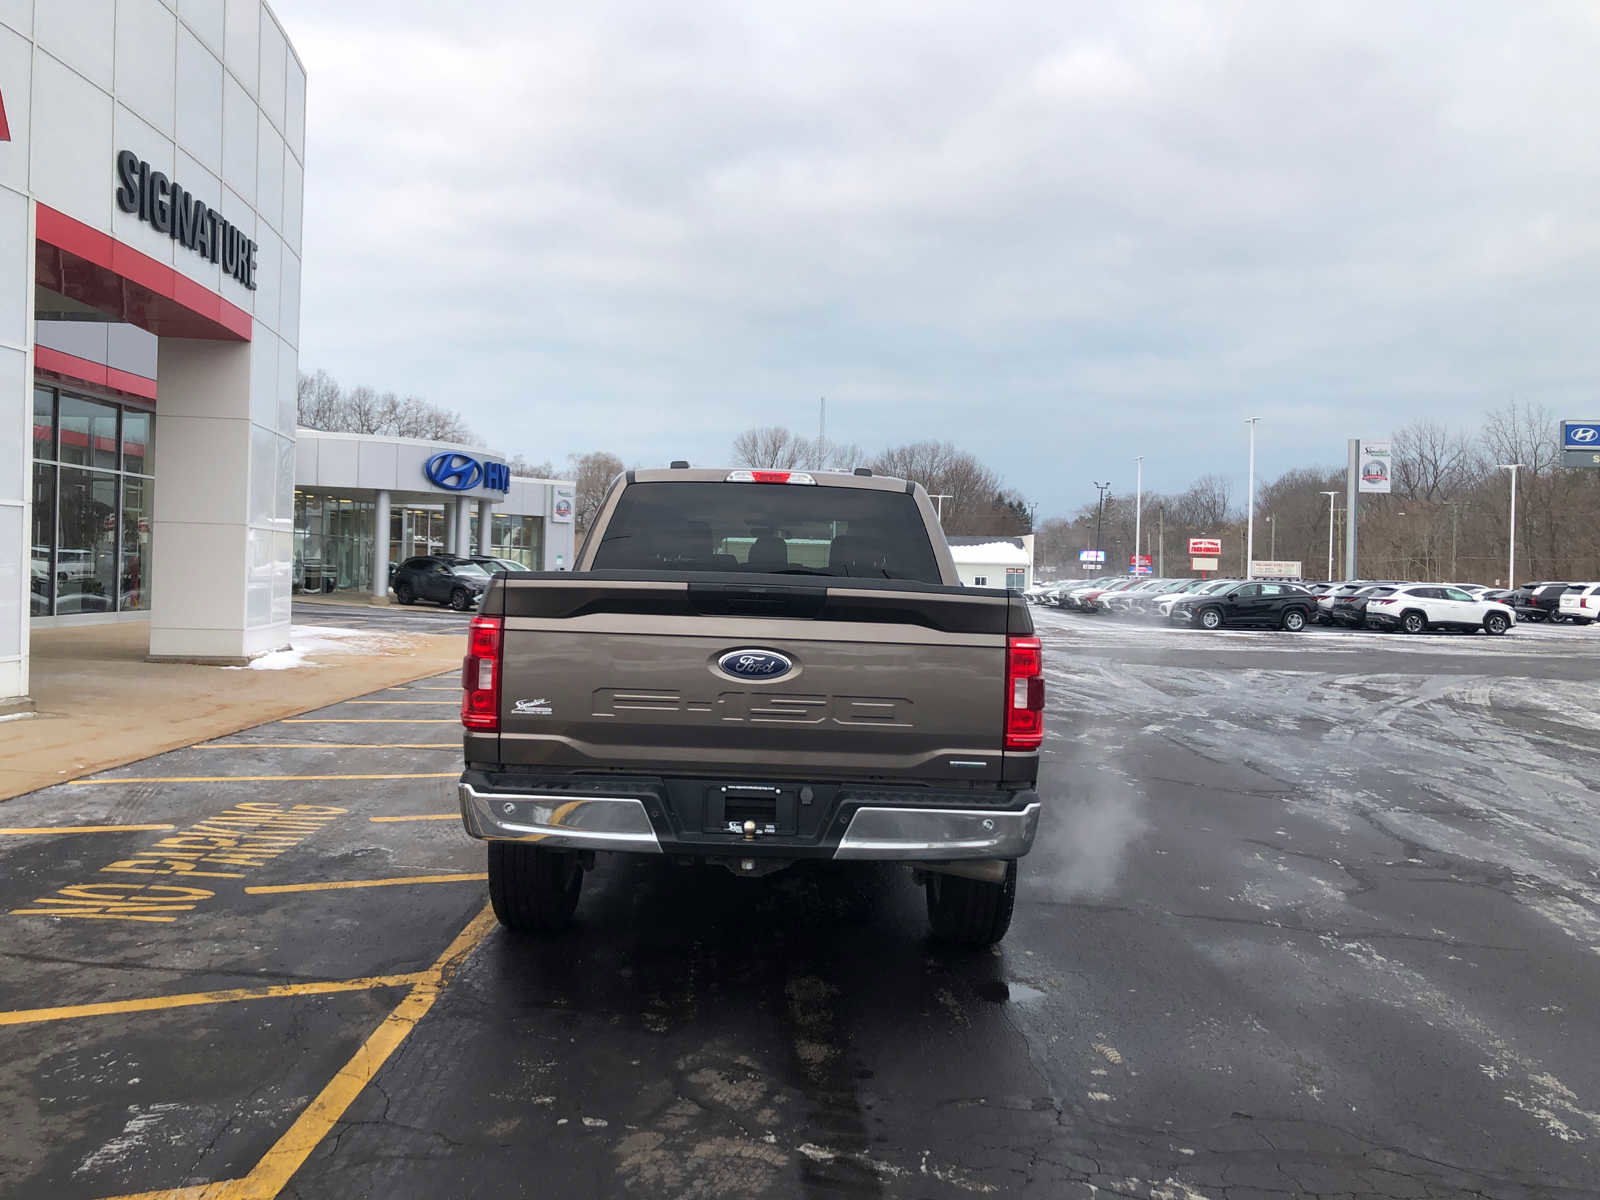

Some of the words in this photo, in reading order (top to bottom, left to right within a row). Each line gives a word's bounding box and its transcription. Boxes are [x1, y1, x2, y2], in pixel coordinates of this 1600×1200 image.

[116, 150, 258, 291] SIGNATURE
[736, 655, 775, 673] Ford
[591, 687, 914, 727] F-150
[100, 802, 349, 878] PARKING
[8, 883, 216, 922] NO
